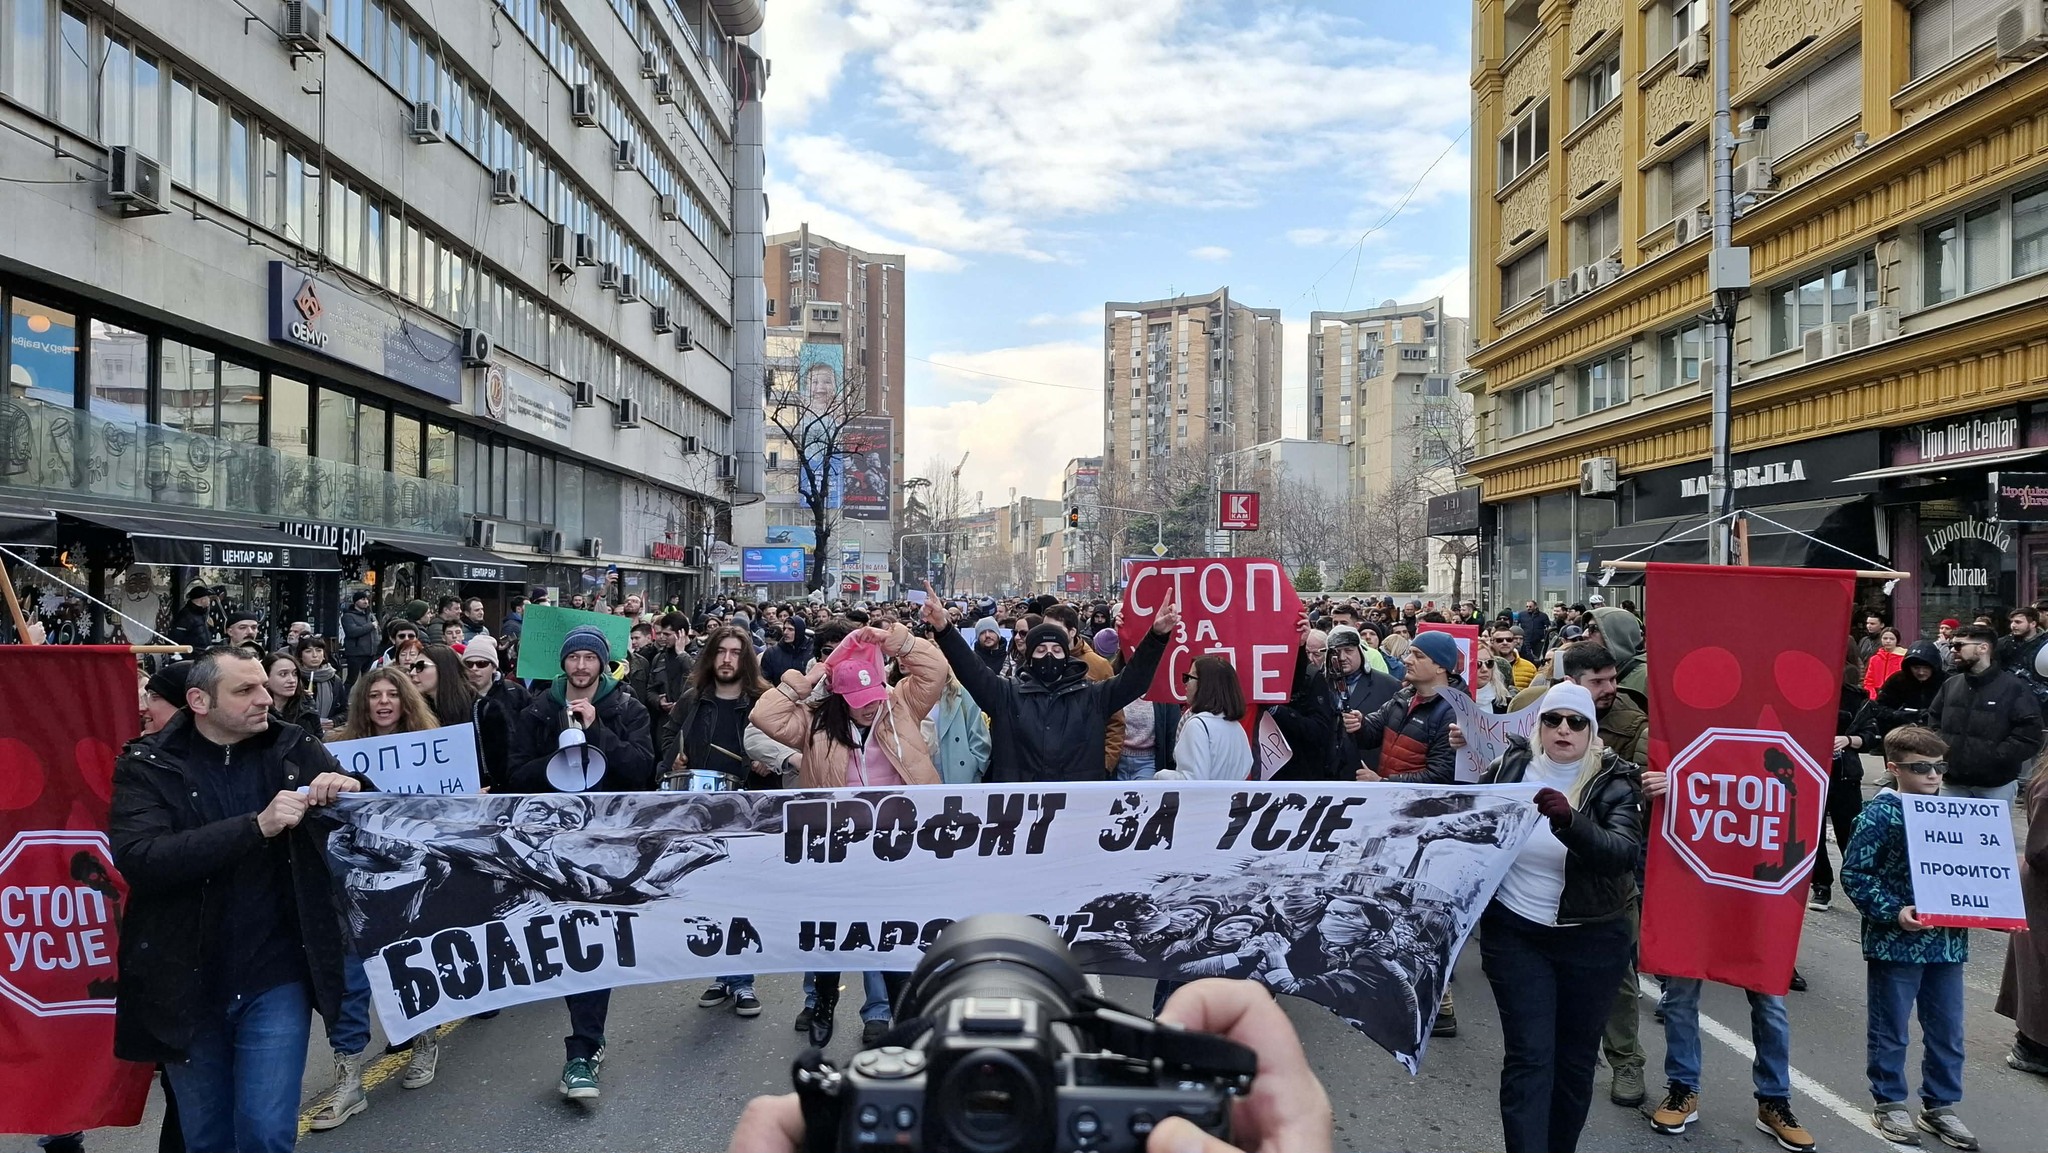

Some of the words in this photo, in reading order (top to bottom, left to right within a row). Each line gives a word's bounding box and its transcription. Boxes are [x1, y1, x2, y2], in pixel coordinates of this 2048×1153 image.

[1921, 428, 1944, 462] Lipo
[1948, 423, 1971, 455] Diet
[1974, 416, 2017, 450] Centar
[222, 549, 255, 564] ЦЕНТАР
[257, 551, 274, 564] БАР
[342, 528, 367, 556] БАР
[1130, 562, 1282, 617] СТОП
[1948, 563, 1987, 587] Ishrana
[1175, 619, 1219, 644] ЗА
[858, 669, 871, 686] S
[334, 738, 450, 774] ОПЈЕ
[1687, 771, 1786, 813] СТОП
[1914, 800, 2000, 819] ВОЗДУХОТ
[783, 792, 1067, 864] ПРОФИТ
[1099, 791, 1181, 853] ЗА
[1689, 808, 1780, 851] УСЈЕ
[1925, 829, 1964, 845] НАШ
[1979, 833, 2001, 847] ЗА
[1920, 861, 2011, 880] ПРОФИТОТ
[0, 885, 108, 928] СТОП
[1951, 893, 1990, 909] ВАШ
[3, 928, 112, 972] УСЈЕ
[382, 908, 640, 1021] БОЛЕСТ
